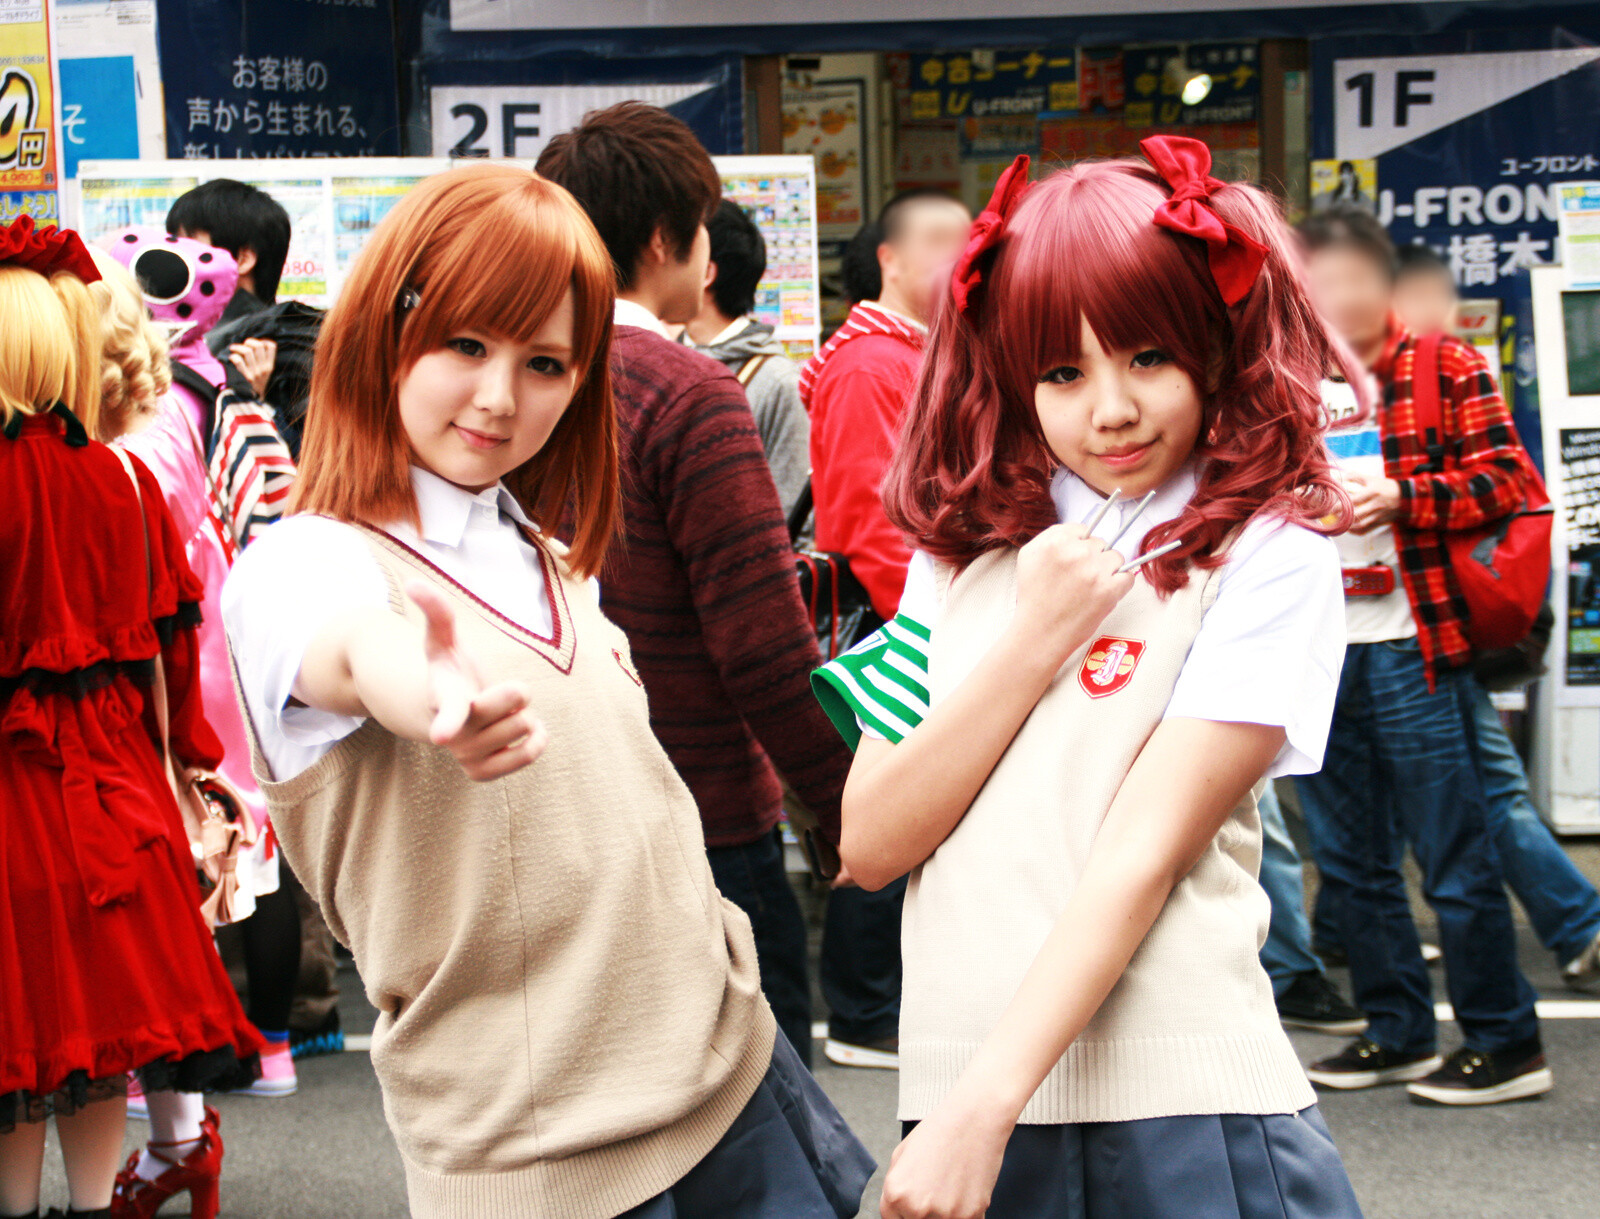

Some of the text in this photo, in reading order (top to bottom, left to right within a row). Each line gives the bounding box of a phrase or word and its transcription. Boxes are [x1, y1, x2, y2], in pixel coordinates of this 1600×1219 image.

[232, 54, 328, 92] お客様の
[186, 96, 368, 139] 声から生まれる、
[1345, 70, 1436, 128] 1F
[449, 103, 542, 157] 2F
[1500, 155, 1600, 176] ユーフロント
[0, 194, 56, 217] しょう!
